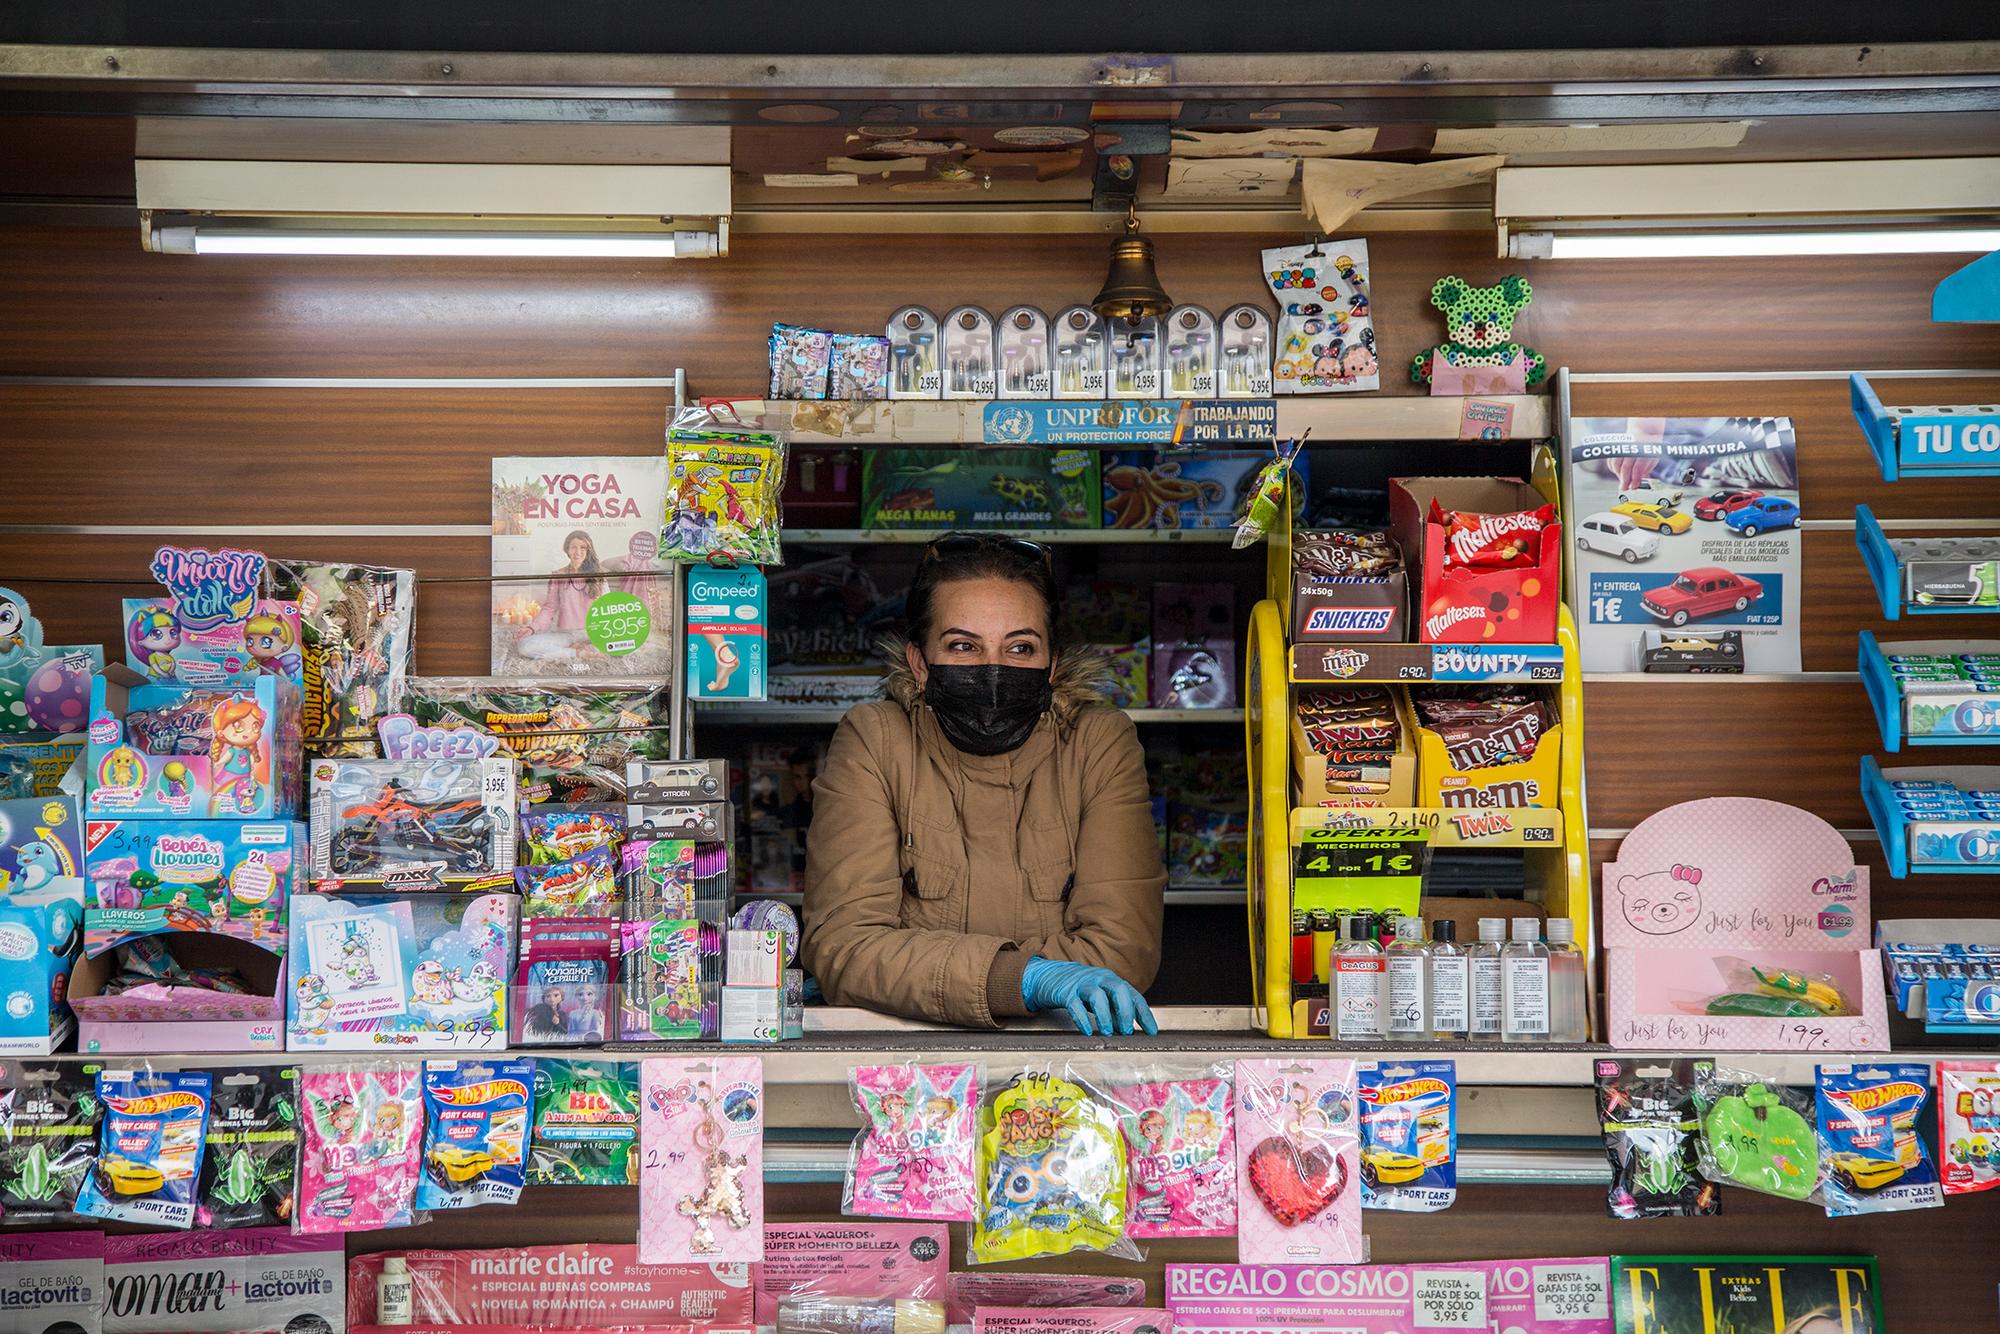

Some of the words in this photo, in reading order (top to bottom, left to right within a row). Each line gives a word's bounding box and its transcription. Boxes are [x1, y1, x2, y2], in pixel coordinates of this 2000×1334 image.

[920, 376, 939, 390] 2,95€
[975, 380, 994, 394] 2,95€
[1030, 378, 1048, 392] 2,95€
[1084, 376, 1102, 389] 2,95€
[1137, 375, 1155, 389] 2,95€
[1193, 376, 1211, 390] 2,95€
[1252, 377, 1269, 392] 2,95€
[1047, 407, 1172, 427] UNPROFOR
[1194, 407, 1275, 422] TRABAJANDO
[1047, 431, 1064, 442] UN
[1067, 430, 1134, 442] PROTECTION
[1136, 429, 1172, 441] FORCE
[1196, 425, 1222, 439] POR
[1227, 425, 1243, 439] LA
[1248, 425, 1274, 440] PAZ
[1914, 425, 1953, 454] TU
[1583, 443, 1639, 459] COCHES
[1643, 444, 1661, 456] EN
[1666, 441, 1747, 456] MINIATURA
[542, 473, 622, 496] YOGA
[523, 498, 561, 520] EN
[566, 498, 642, 519] CASA
[876, 509, 910, 522] MEGA
[912, 509, 956, 522] RANAS
[973, 511, 1001, 522] MEGA
[1004, 511, 1053, 523] GRANDES
[1452, 513, 1543, 563] Maltesers
[691, 581, 758, 602] Compeed
[1301, 587, 1333, 599] 24x50g
[1603, 582, 1641, 593] ENTREGA
[591, 608, 600, 617] 2
[601, 602, 642, 616] LIBROS
[1592, 598, 1623, 622] 1€
[1307, 609, 1395, 631] SNICKERS
[1426, 605, 1487, 640] Maltesers
[1432, 654, 1528, 676] BOUNTY
[485, 777, 505, 793] 3,95€
[1443, 777, 1467, 786] PEANUT
[1453, 812, 1513, 839] Twix
[89, 824, 109, 845] NEW
[656, 831, 675, 839] BMW
[1310, 828, 1421, 839] OFERTA
[162, 836, 208, 853] Bebés
[1316, 841, 1402, 850] MECHEROS
[250, 850, 265, 865] 24
[1306, 855, 1331, 873] 4
[1365, 854, 1414, 872] 1€
[101, 910, 146, 921] LLAVEROS
[1705, 911, 1743, 934] Just
[1751, 907, 1774, 931] for
[1785, 913, 1817, 938] You
[1341, 960, 1379, 970] DeAGUS
[544, 967, 594, 980] ХОЛОДНОЕ
[1625, 1019, 1665, 1042] Just
[1667, 1017, 1689, 1040] for
[1696, 1025, 1728, 1045] You
[27, 1100, 54, 1114] BIG
[570, 1092, 611, 1111] BIG
[1643, 1098, 1669, 1111] BIG
[229, 1107, 255, 1121] BIG
[545, 1112, 588, 1122] ANIMAL
[592, 1112, 635, 1122] WORLD
[646, 1149, 686, 1169] 2,99
[1427, 1191, 1450, 1200] CARS
[133, 1200, 162, 1213] SPORT
[165, 1205, 189, 1217] CARS
[764, 1231, 812, 1240] ESPECIAL
[211, 1237, 278, 1255] BEAUTY
[764, 1241, 796, 1251] SÚPER
[798, 1241, 854, 1250] MOMENTO
[856, 1241, 901, 1250] BELLEZA
[471, 1252, 542, 1276] marie
[546, 1250, 614, 1276] claire
[262, 1270, 281, 1281] GEL
[282, 1270, 295, 1280] DE
[298, 1267, 325, 1279] BAÑO
[624, 1265, 688, 1278] #stayhome
[1547, 1273, 1583, 1283] REVISTA
[19, 1277, 36, 1288] GEL
[40, 1277, 53, 1287] DE
[56, 1274, 84, 1286] BAÑO
[245, 1277, 321, 1299] lactovit
[482, 1281, 536, 1292] ESPECIAL
[540, 1281, 587, 1292] BUENAS
[590, 1281, 652, 1292] COMPRAS
[1172, 1268, 1287, 1296] REGALO
[1296, 1269, 1410, 1298] COSMO
[1427, 1280, 1463, 1289] REVISTA
[1537, 1283, 1568, 1293] GAFAS
[1570, 1283, 1583, 1292] DE
[1584, 1282, 1603, 1292] SOL
[1720, 1277, 1762, 1286] EXTRAS
[0, 1285, 80, 1306] lactovit
[681, 1290, 728, 1300] AUTHENTIC
[1416, 1290, 1448, 1300] GAFAS
[1449, 1290, 1462, 1299] DE
[1463, 1290, 1482, 1300] SOL
[1733, 1285, 1752, 1293] Kids
[482, 1299, 530, 1310] NOVELA
[533, 1296, 606, 1310] ROMÁNTICA
[621, 1297, 675, 1311] CHAMPÚ
[681, 1300, 713, 1310] BEAUTY
[1424, 1301, 1446, 1311] POR
[1545, 1294, 1567, 1304] POR
[680, 1308, 718, 1319] CONCEPT
[1176, 1306, 1212, 1315] ESTRENA
[1214, 1307, 1242, 1315] GAFAS
[1255, 1307, 1272, 1315] SOL
[1323, 1308, 1346, 1317] PARA
[1555, 1303, 1580, 1315] 3,95
[1289, 1316, 1325, 1324] Protección
[1433, 1311, 1459, 1323] 3,95
